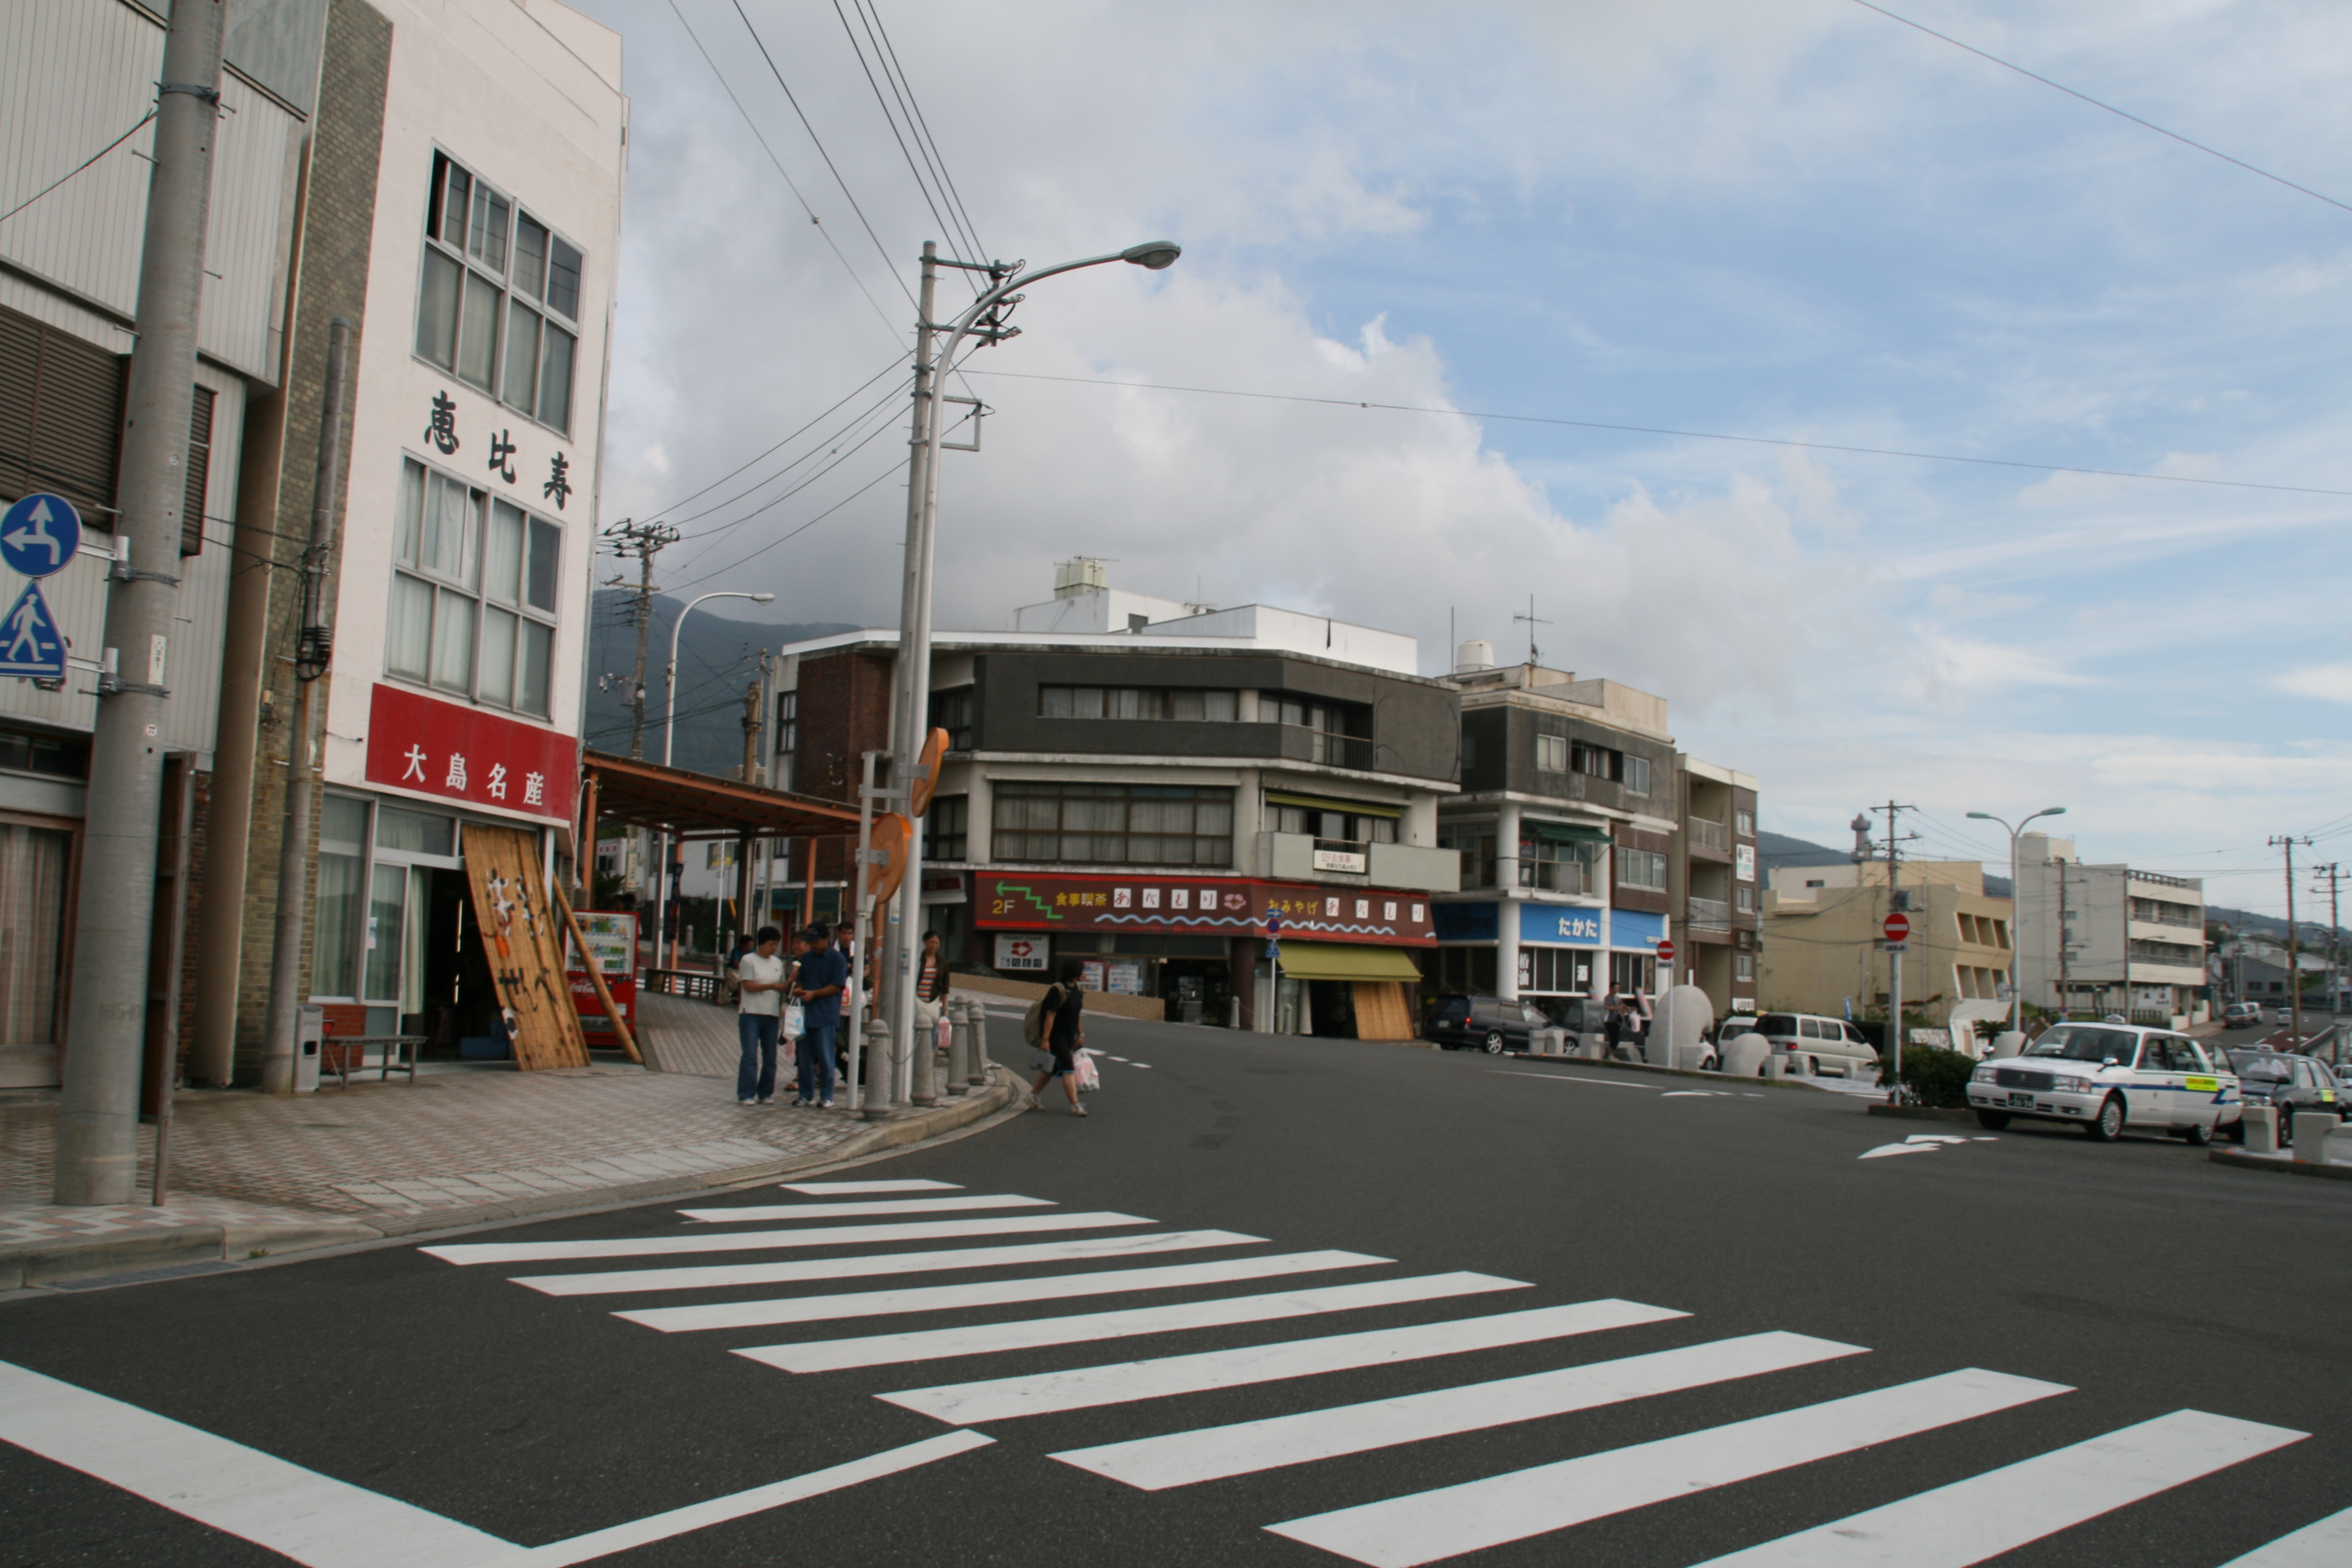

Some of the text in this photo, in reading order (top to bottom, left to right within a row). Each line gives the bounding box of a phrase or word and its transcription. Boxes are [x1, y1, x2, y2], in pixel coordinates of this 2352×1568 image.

[424, 390, 572, 511] 恵比寿
[402, 743, 544, 806] 大島名産
[992, 899, 1015, 914] 2F
[1056, 892, 1108, 907] 食事喫茶
[1558, 917, 1598, 938] たかた
